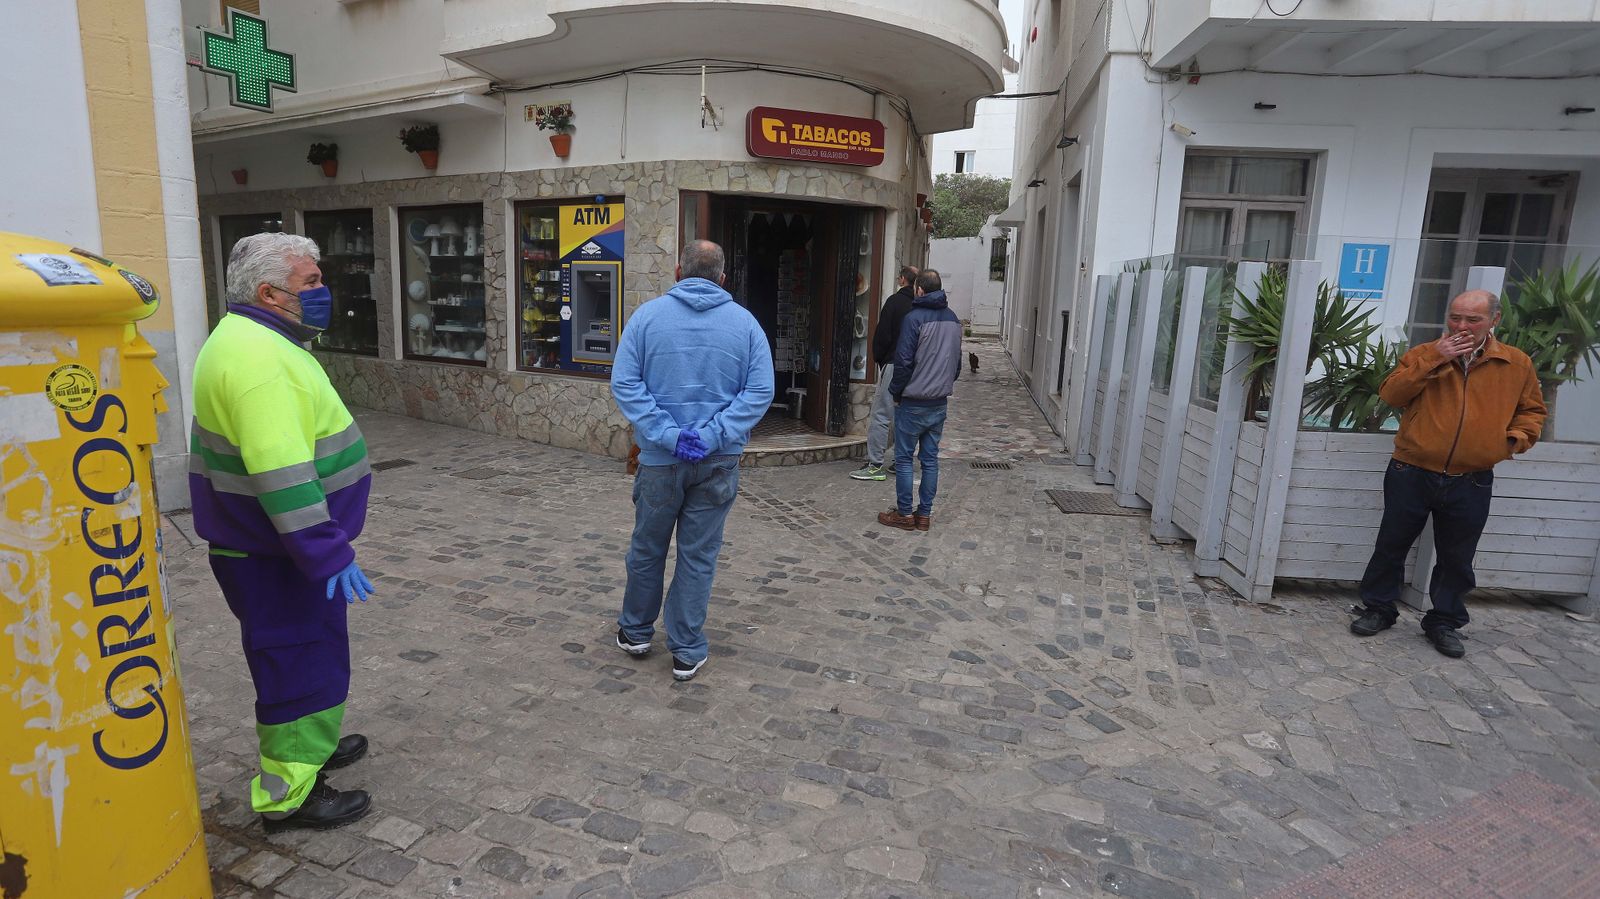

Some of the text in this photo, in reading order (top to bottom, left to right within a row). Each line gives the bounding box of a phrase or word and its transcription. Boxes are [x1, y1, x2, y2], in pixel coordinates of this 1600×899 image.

[791, 123, 872, 147] TABACOS
[573, 206, 610, 226] ATM
[1351, 247, 1378, 274] H
[65, 393, 169, 770] CORREOS
